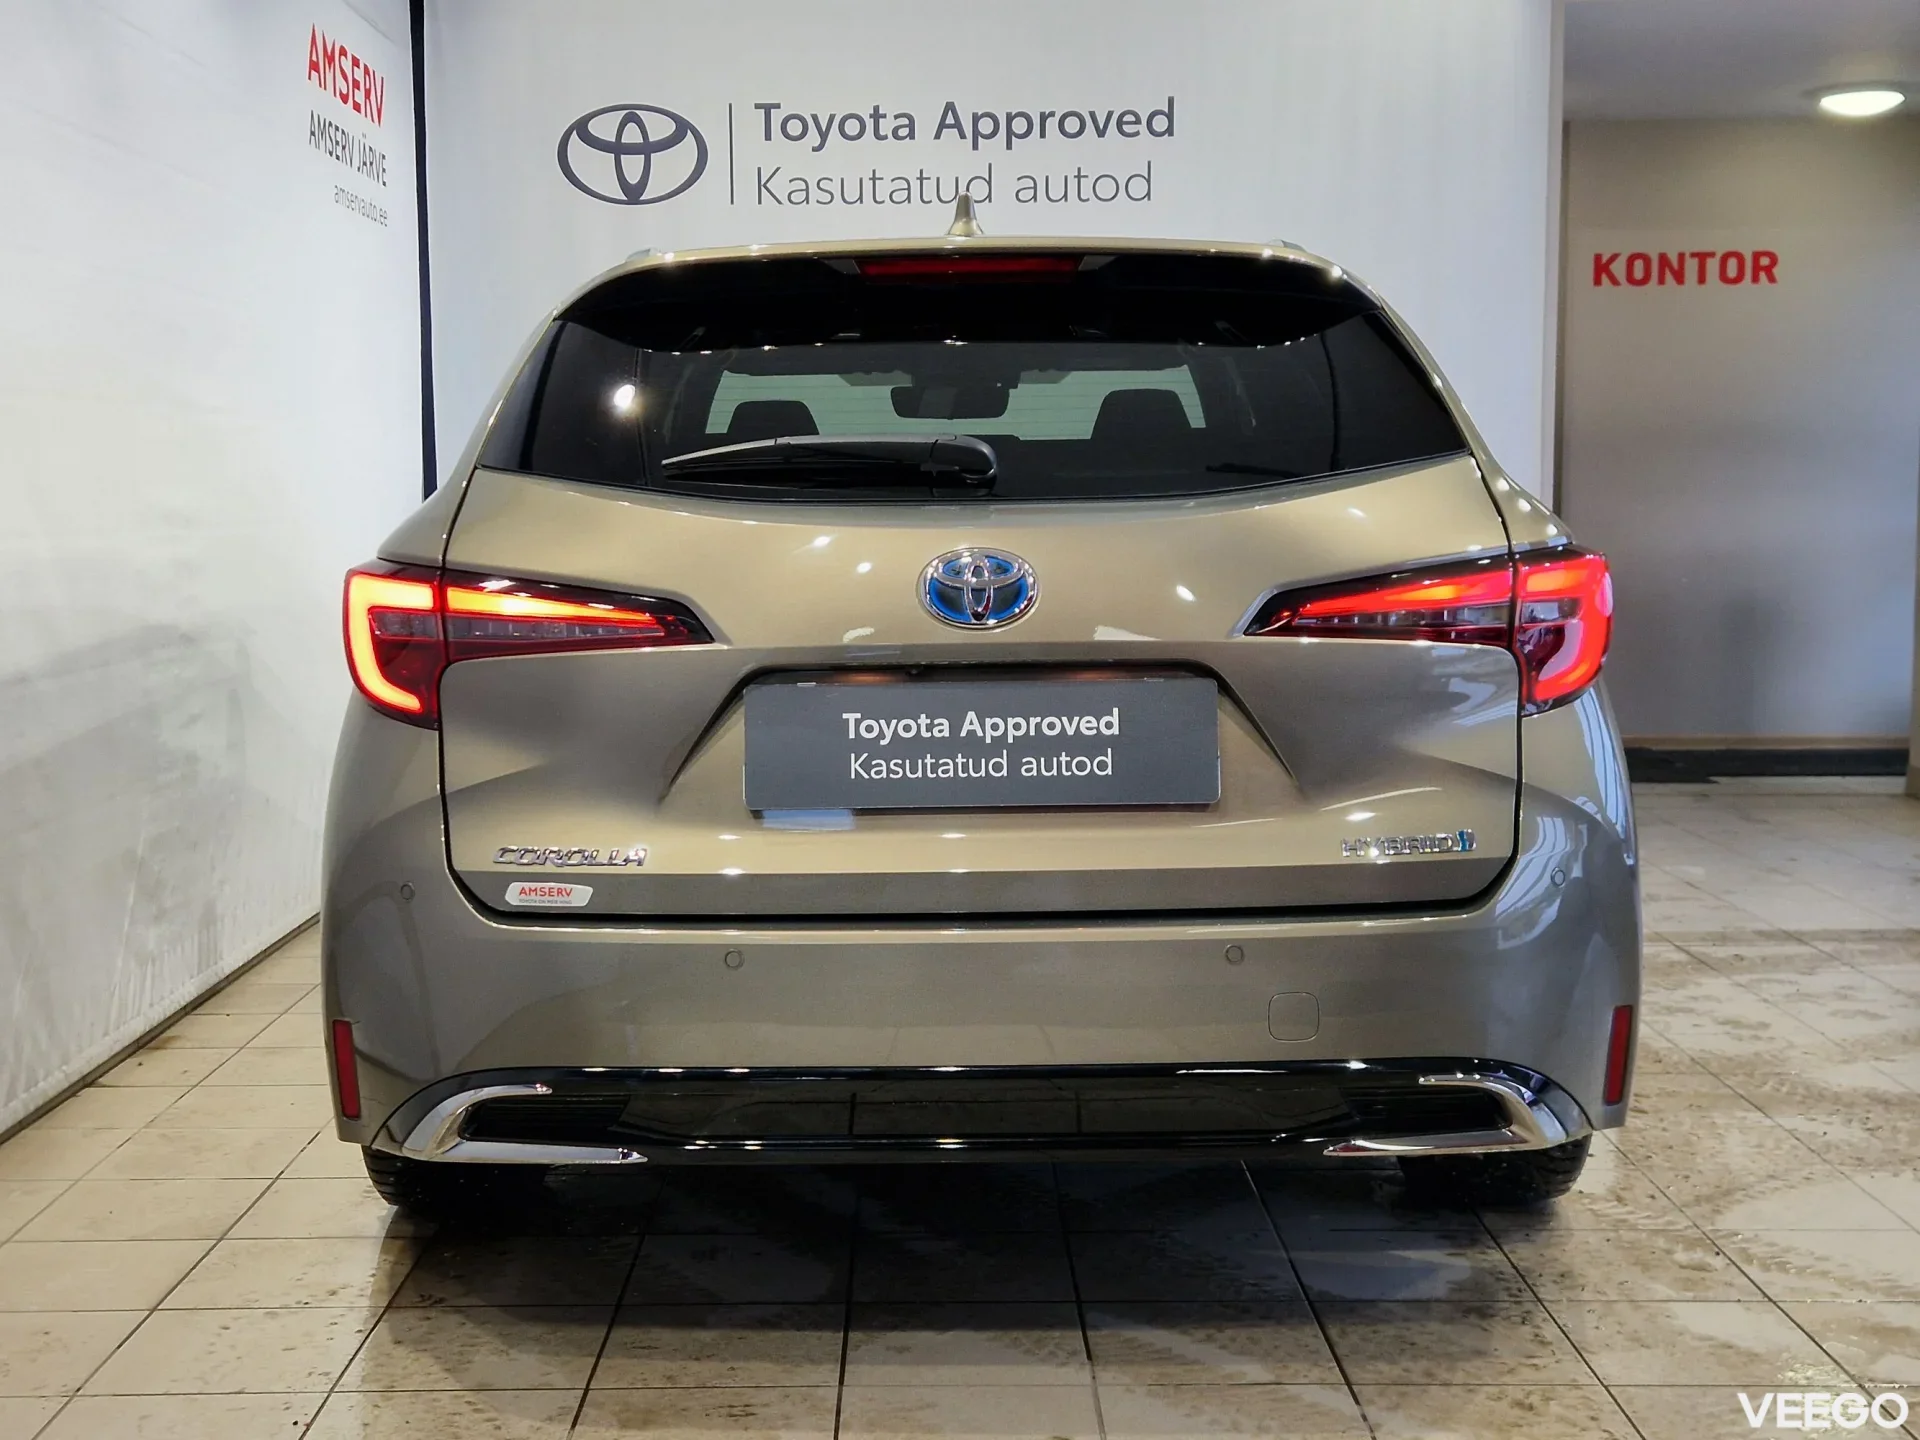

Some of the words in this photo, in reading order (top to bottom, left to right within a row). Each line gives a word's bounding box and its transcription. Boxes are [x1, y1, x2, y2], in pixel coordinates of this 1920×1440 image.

[307, 23, 385, 127] AMSERV
[754, 102, 915, 152] Toyota
[933, 96, 1175, 151] Approved
[308, 109, 355, 168] AMSERV
[357, 133, 387, 187] JÄRVE
[756, 162, 994, 206] Kasutatud
[1015, 160, 1152, 204] autod
[334, 185, 388, 227] amservauto.ee
[1592, 250, 1779, 287] KONTOR
[842, 712, 950, 745] Toyota
[959, 707, 1120, 743] Approved
[849, 749, 1008, 779] Kasutatud
[1020, 748, 1113, 776] autod
[493, 845, 648, 867] COROLLA
[1340, 833, 1453, 857] HYBRID
[518, 886, 573, 897] AMSERV
